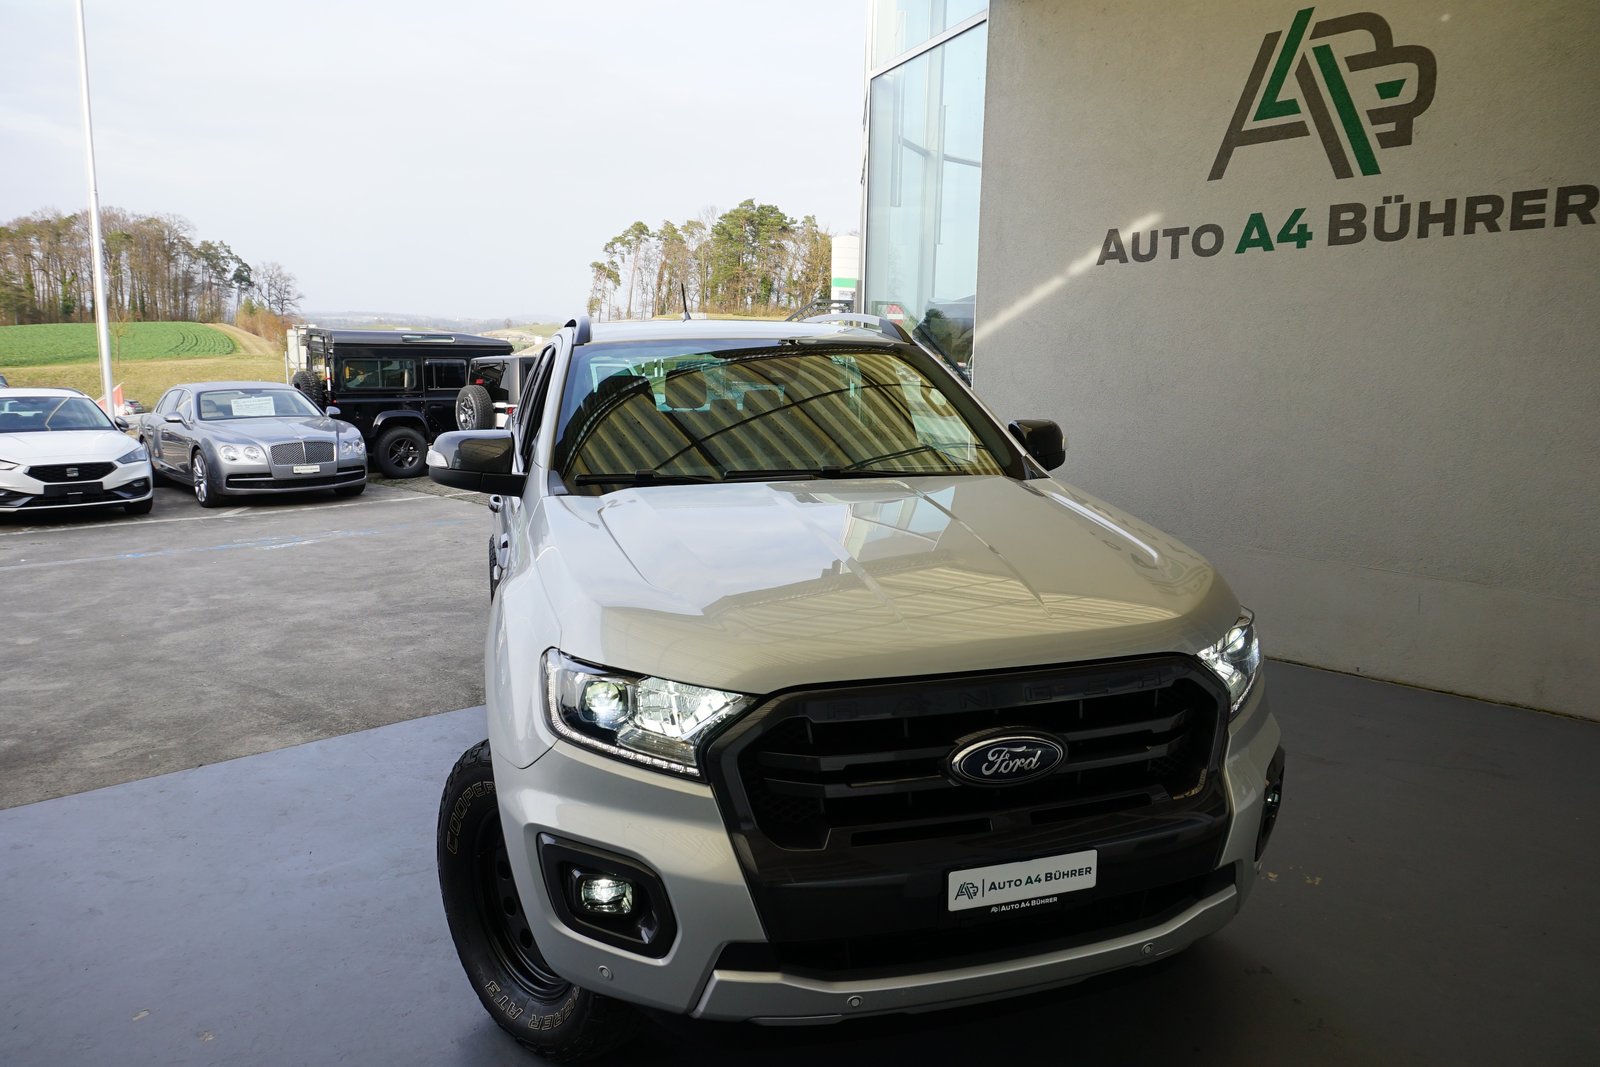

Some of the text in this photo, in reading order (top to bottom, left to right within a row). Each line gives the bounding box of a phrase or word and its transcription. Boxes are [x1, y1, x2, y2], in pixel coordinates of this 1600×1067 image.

[1096, 184, 1599, 267] AUTO A4 BÜHRER
[981, 745, 1042, 776] Ford
[988, 879, 1023, 891] AUTO
[1024, 873, 1042, 886] A4
[1044, 867, 1093, 881] BÜHRER
[1001, 903, 1020, 911] AUTO
[1031, 896, 1057, 905] BÜHRER
